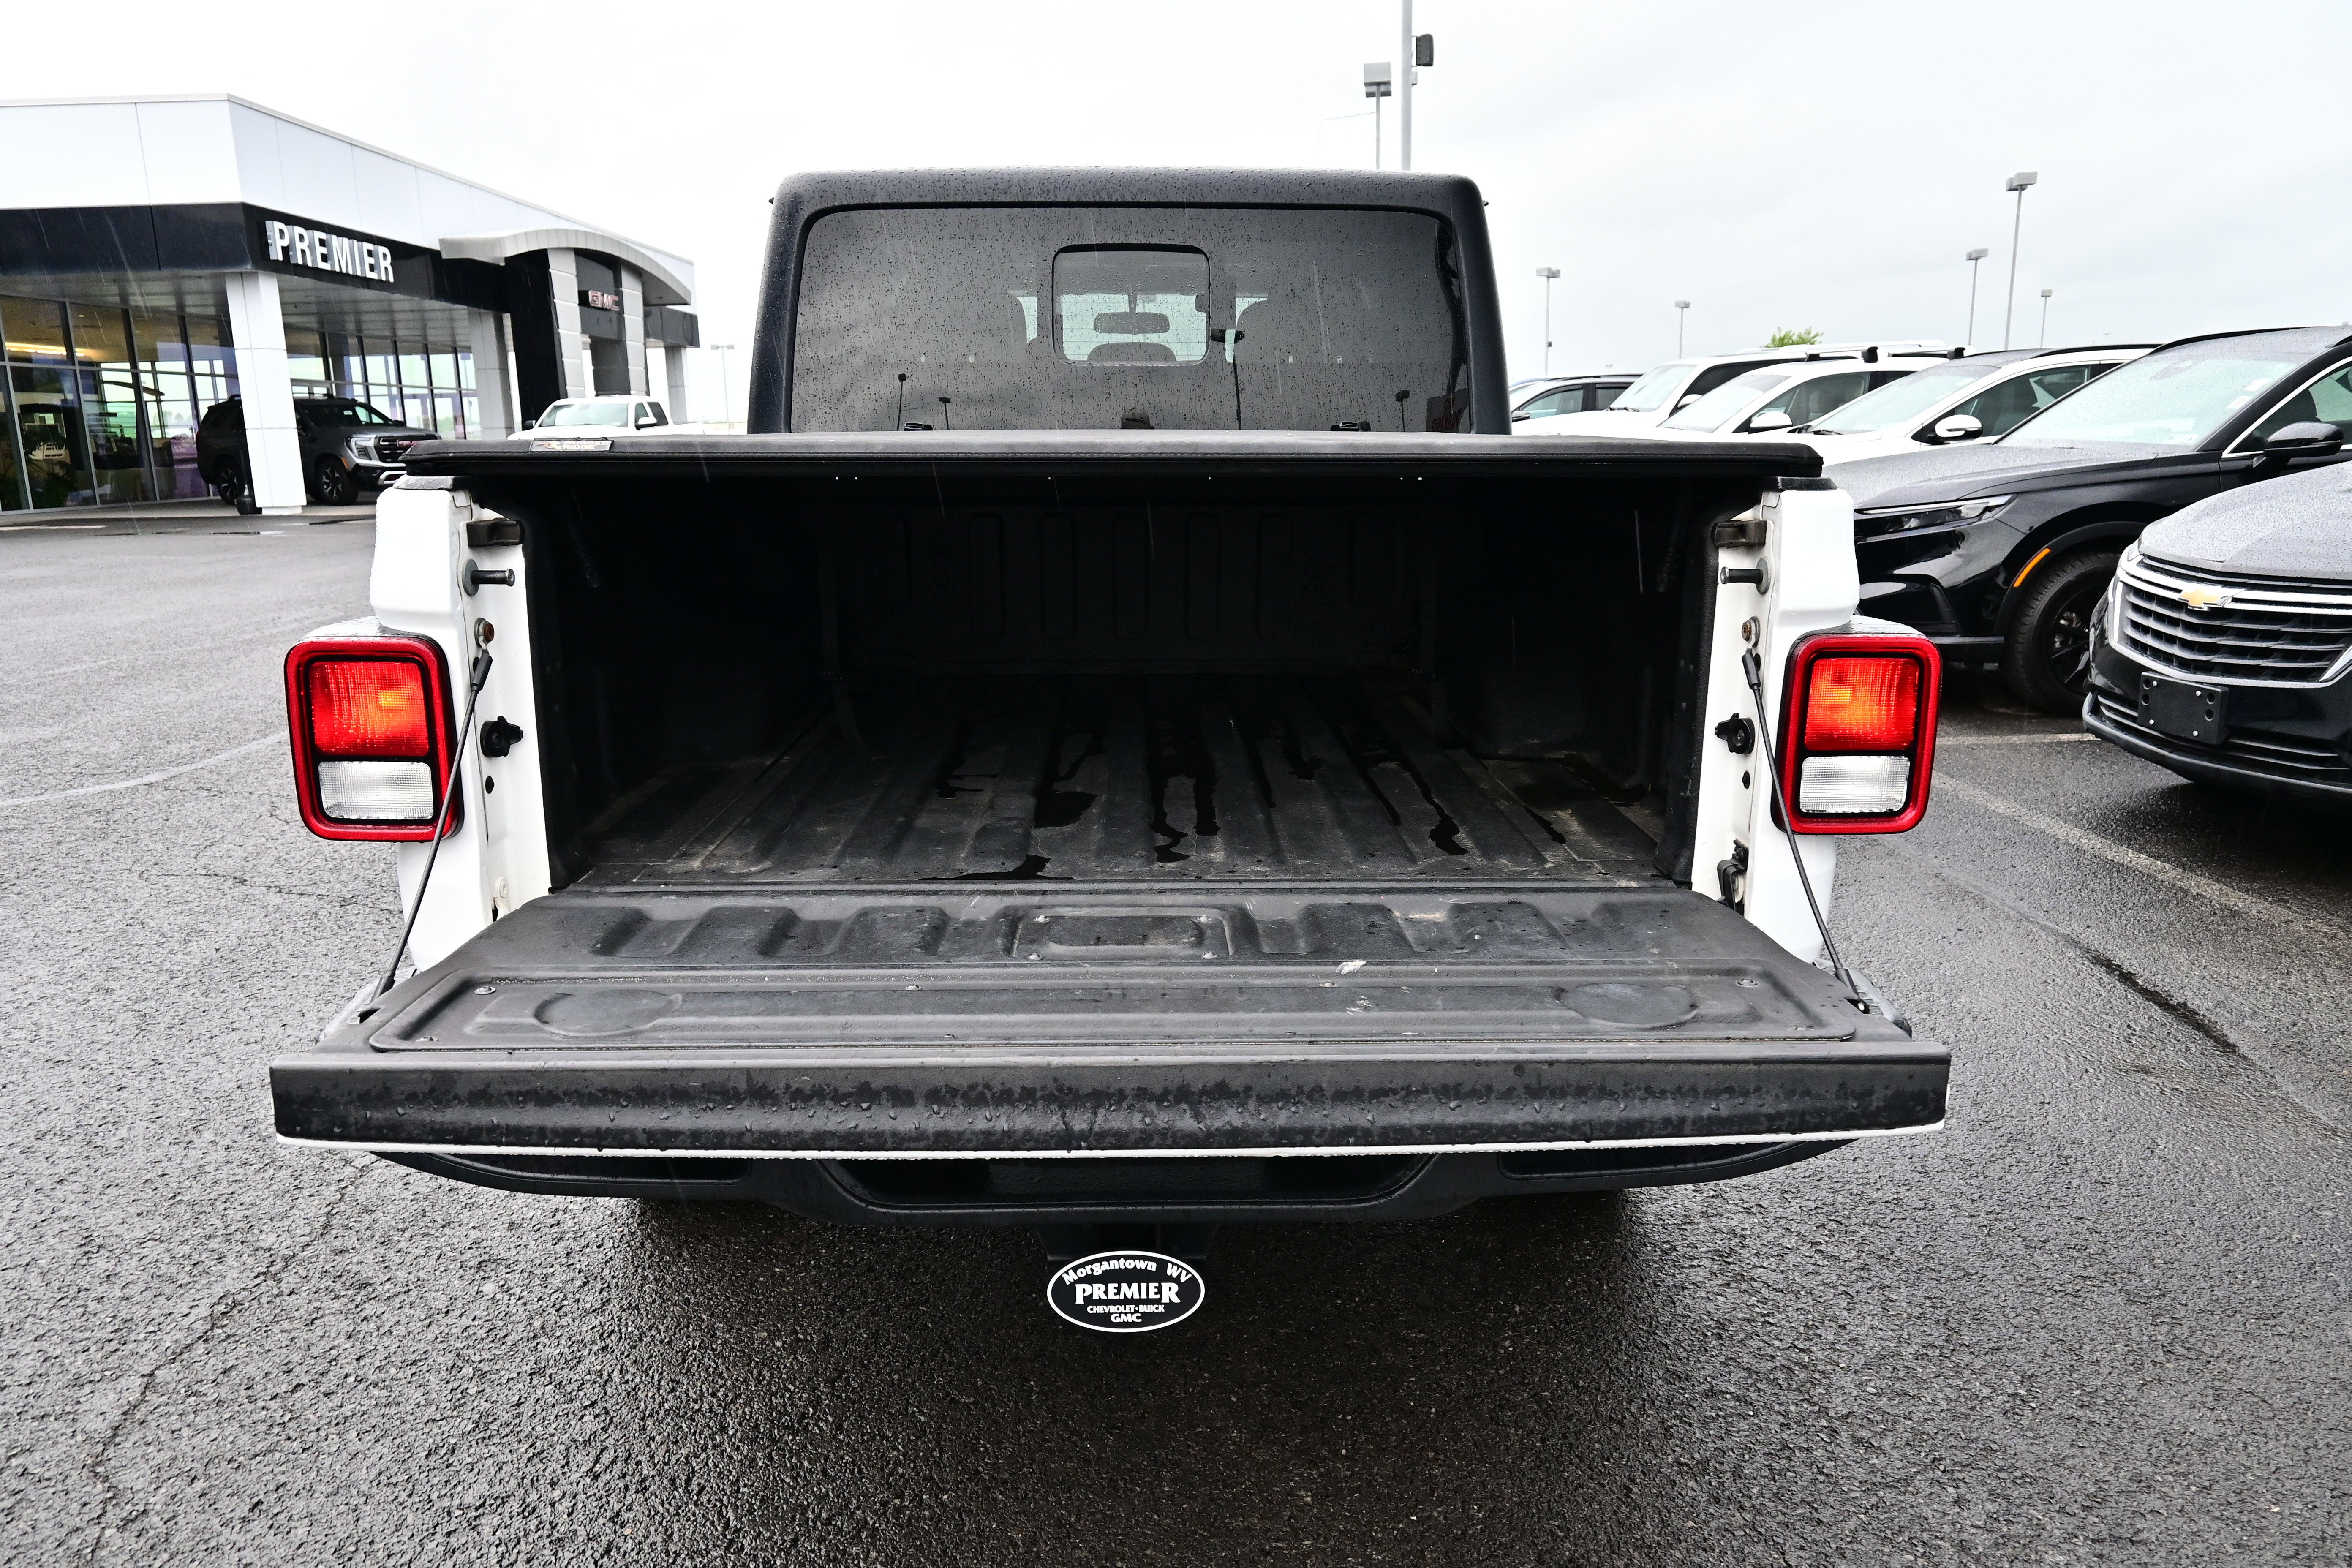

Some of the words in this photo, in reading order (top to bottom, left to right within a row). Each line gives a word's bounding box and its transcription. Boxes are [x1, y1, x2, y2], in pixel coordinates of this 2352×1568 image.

[265, 220, 394, 282] PREMIER
[588, 290, 619, 311] GMC
[1062, 1257, 1157, 1285] Morgantown
[1166, 1263, 1192, 1283] WV
[1075, 1282, 1181, 1305] PREMIER
[1110, 1314, 1142, 1323] GMC
